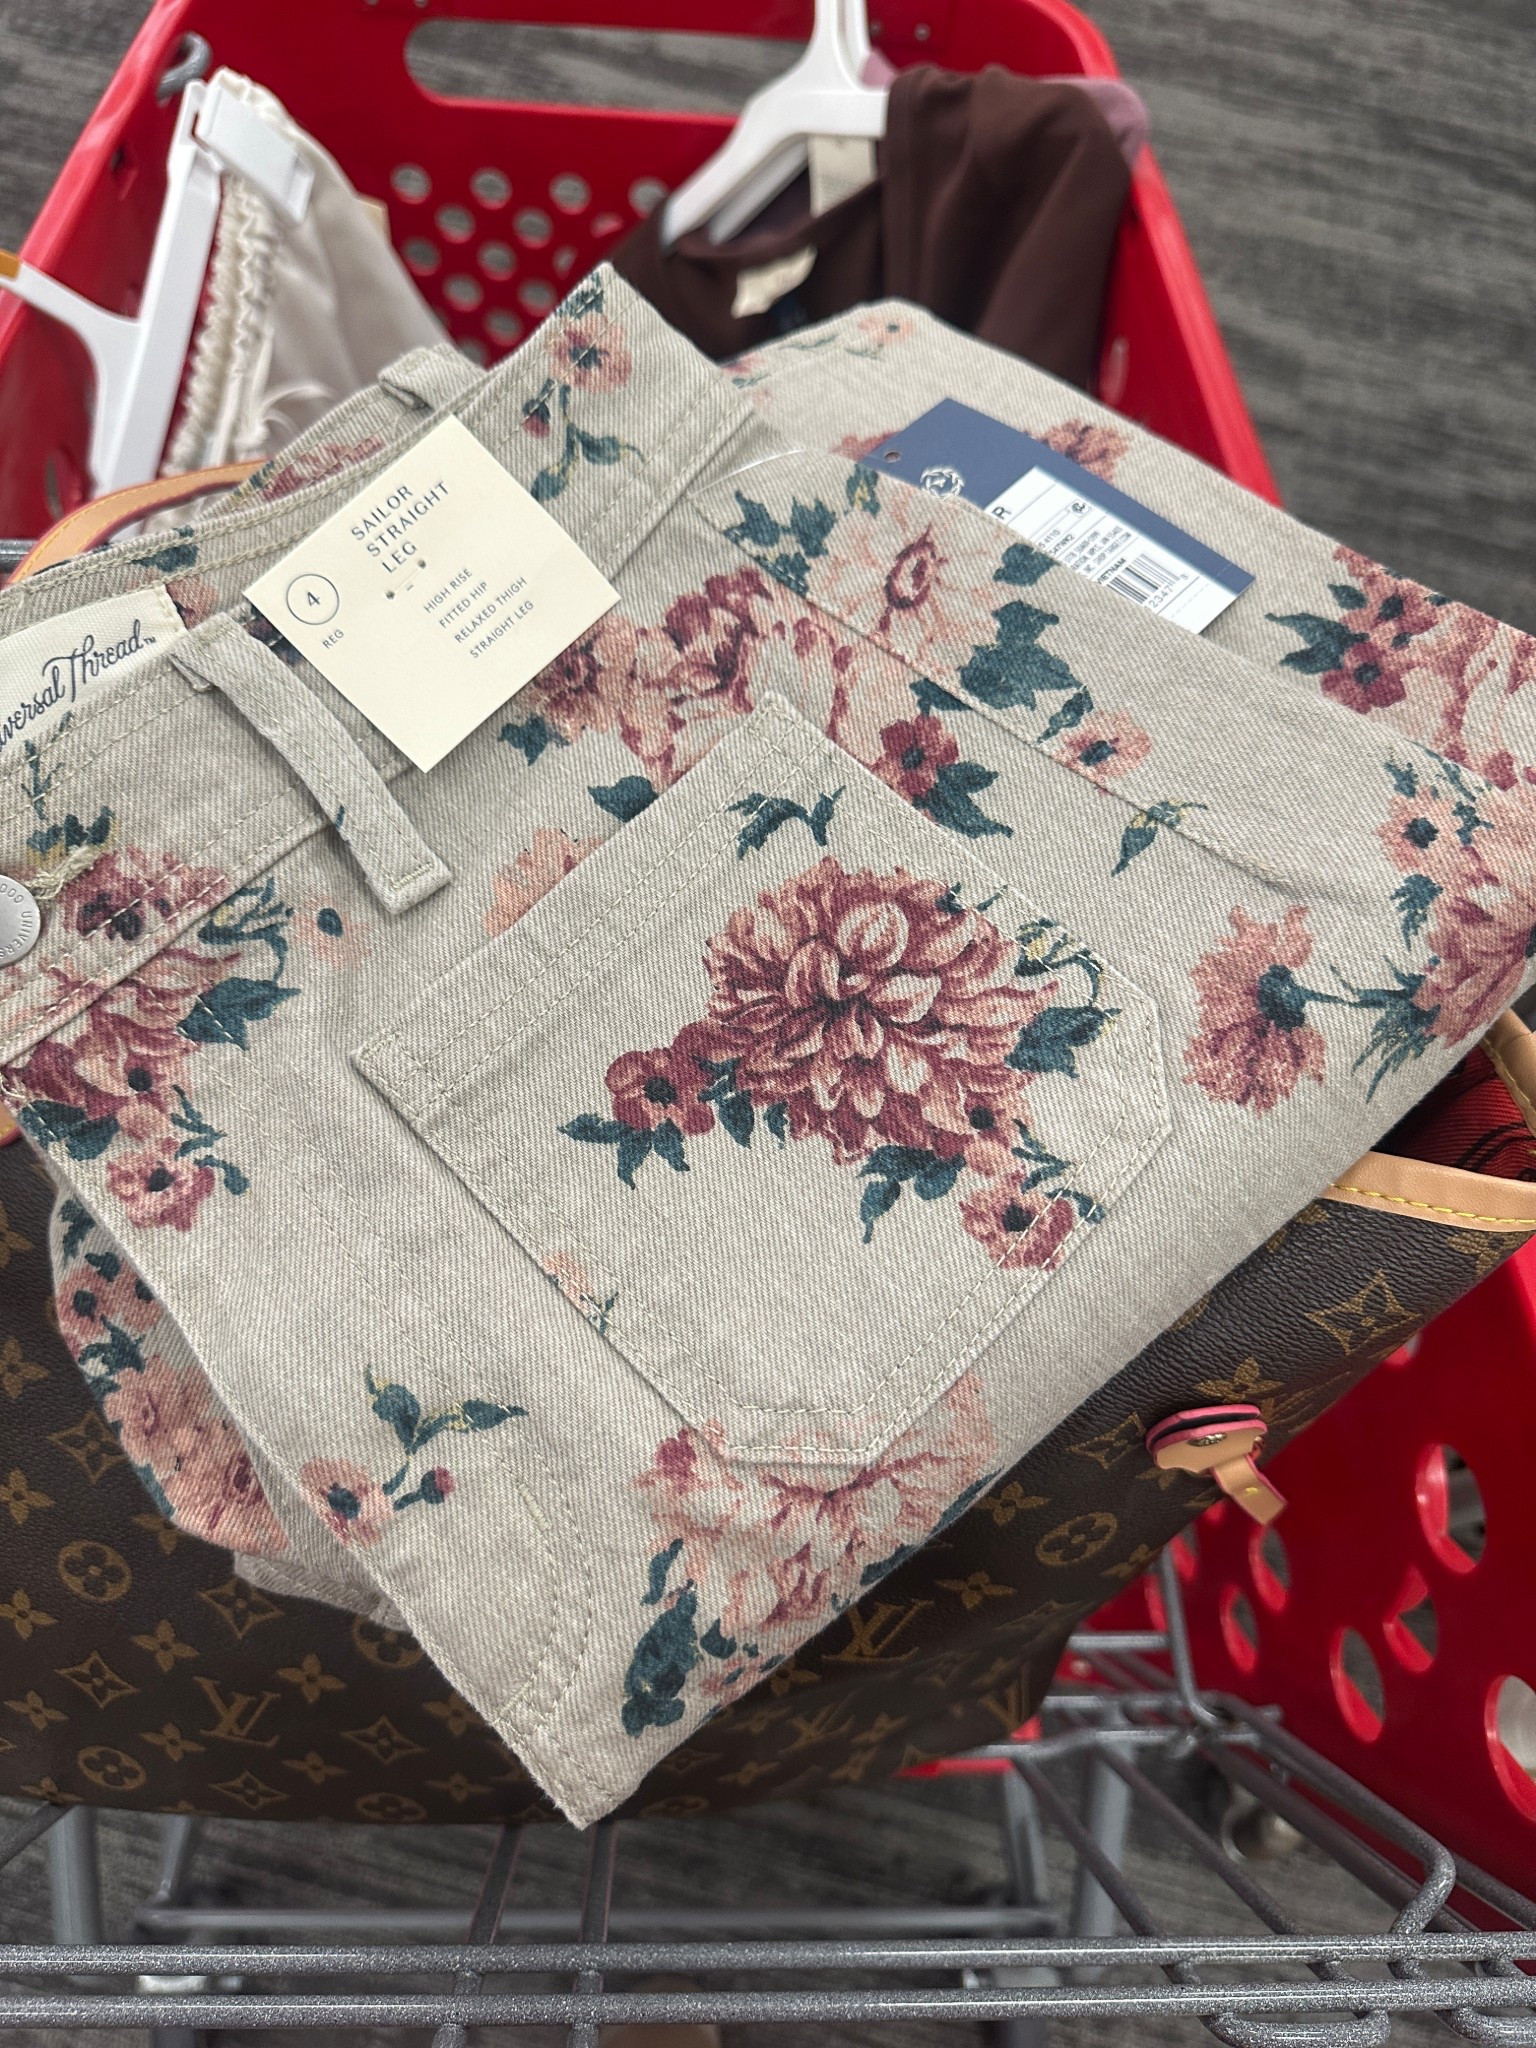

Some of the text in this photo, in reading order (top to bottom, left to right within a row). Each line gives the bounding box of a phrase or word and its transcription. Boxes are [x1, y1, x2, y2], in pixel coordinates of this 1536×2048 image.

[351, 486, 413, 540] SAILOR
[367, 481, 449, 557] STRAIGHT
[992, 506, 1012, 520] R
[382, 541, 418, 573] LEG
[307, 591, 321, 606] 4
[423, 568, 473, 613] HIGH RISE
[439, 581, 488, 628] FITTED HIP
[454, 577, 527, 643] RELAXED THIGH
[322, 629, 344, 649] REG
[470, 600, 534, 659] STRAIGHT LEG
[193, 1675, 281, 1748] LV
